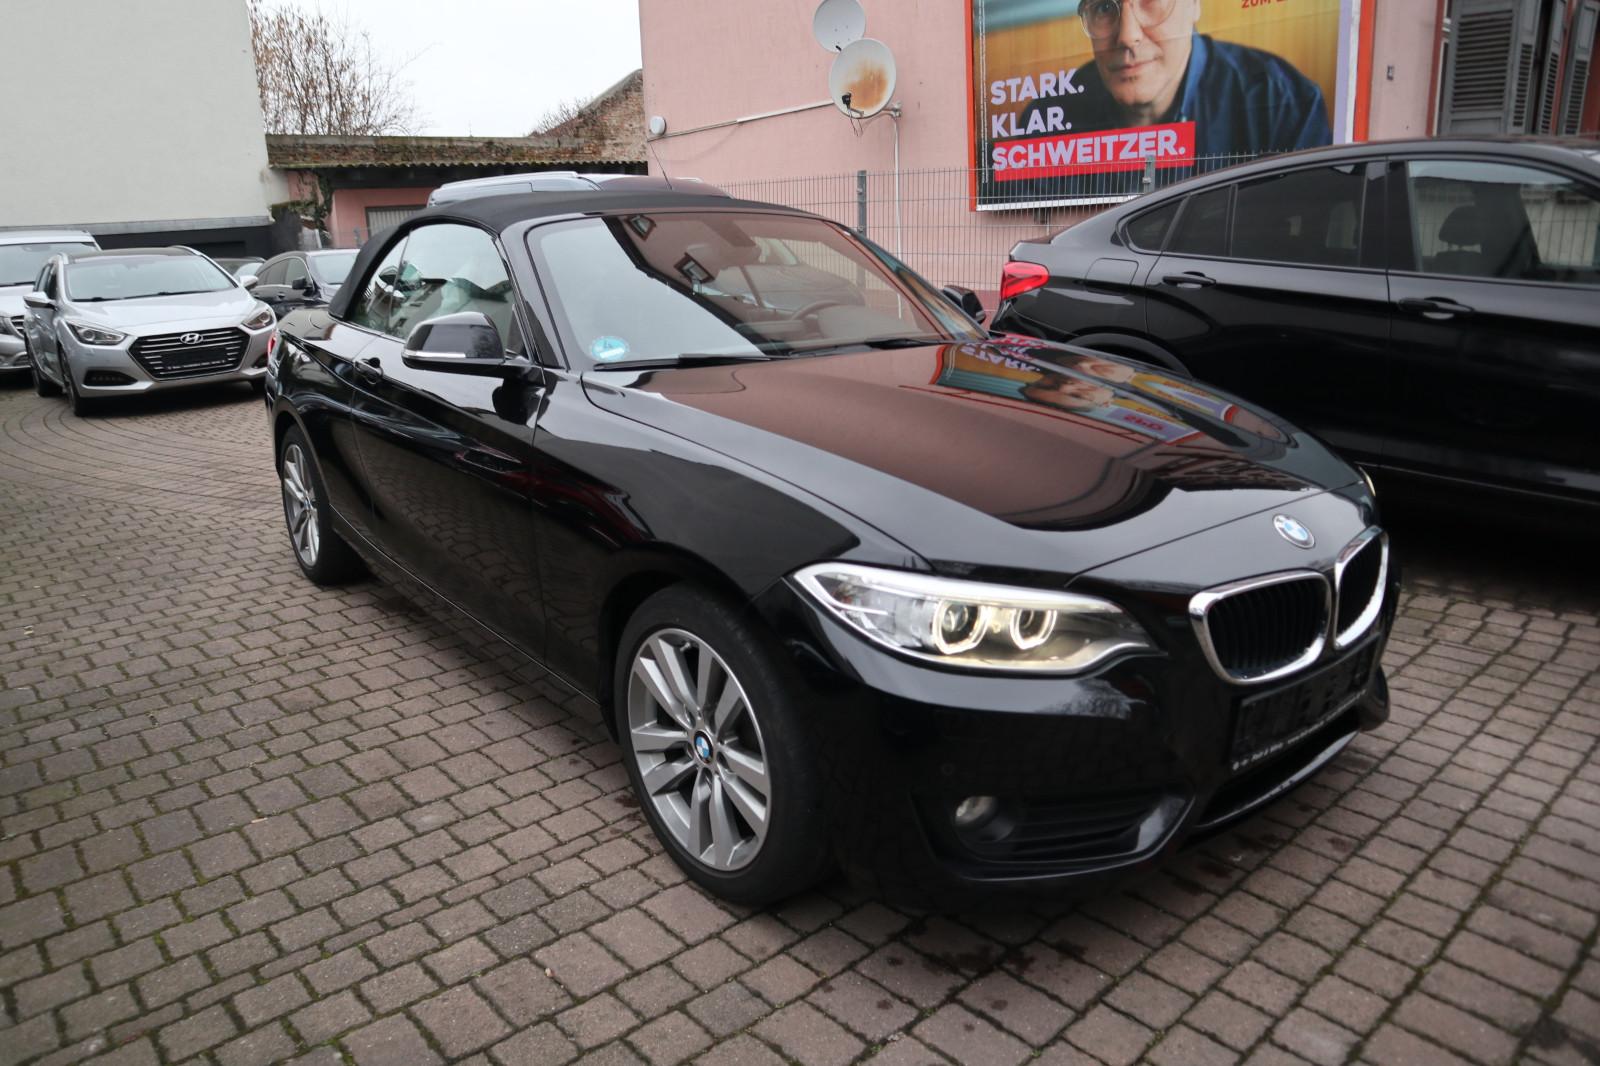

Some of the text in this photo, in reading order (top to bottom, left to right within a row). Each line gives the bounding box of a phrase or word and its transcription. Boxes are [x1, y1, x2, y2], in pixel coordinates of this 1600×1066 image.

[990, 69, 1084, 105] STARK.
[991, 107, 1072, 138] KLAR.
[992, 129, 1186, 171] SCHWEITZER.
